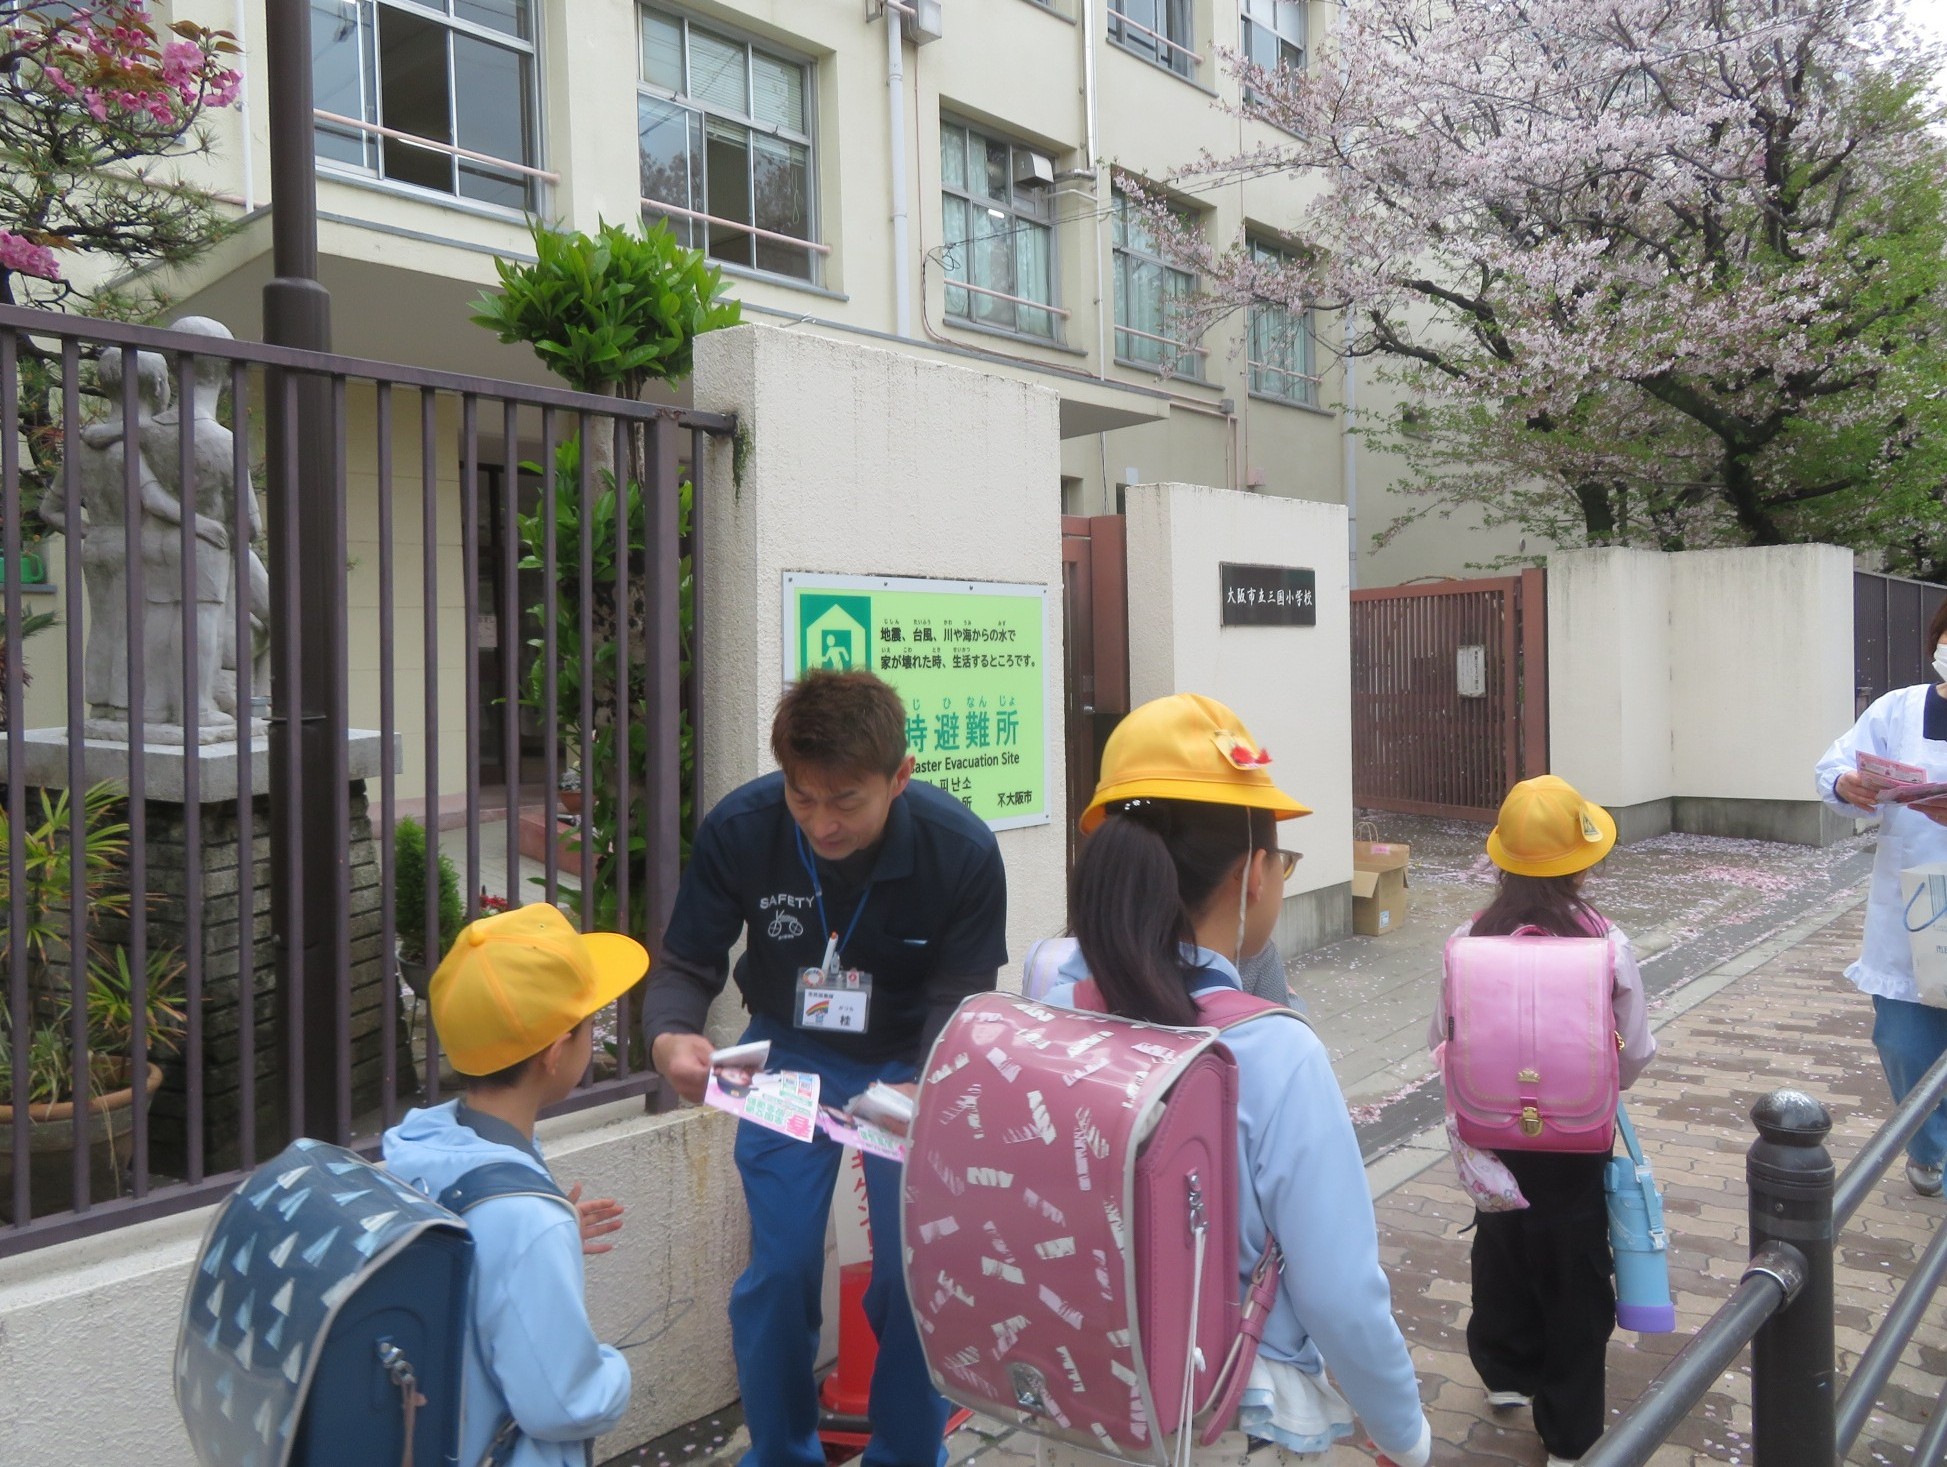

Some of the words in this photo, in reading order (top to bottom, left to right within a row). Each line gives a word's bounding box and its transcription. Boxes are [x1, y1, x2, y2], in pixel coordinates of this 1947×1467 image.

[1227, 587, 1313, 606] 大阪市立三国小学校
[880, 627, 1016, 642] 地震、台風、川や海からの水で
[880, 654, 1036, 670] 家が壊れた時、生活するところです。
[945, 754, 999, 770] Evacuation
[1001, 751, 1020, 765] Site
[940, 777, 972, 792] 피난소
[1007, 790, 1032, 806] 大阪市
[760, 893, 815, 910] SAFETY
